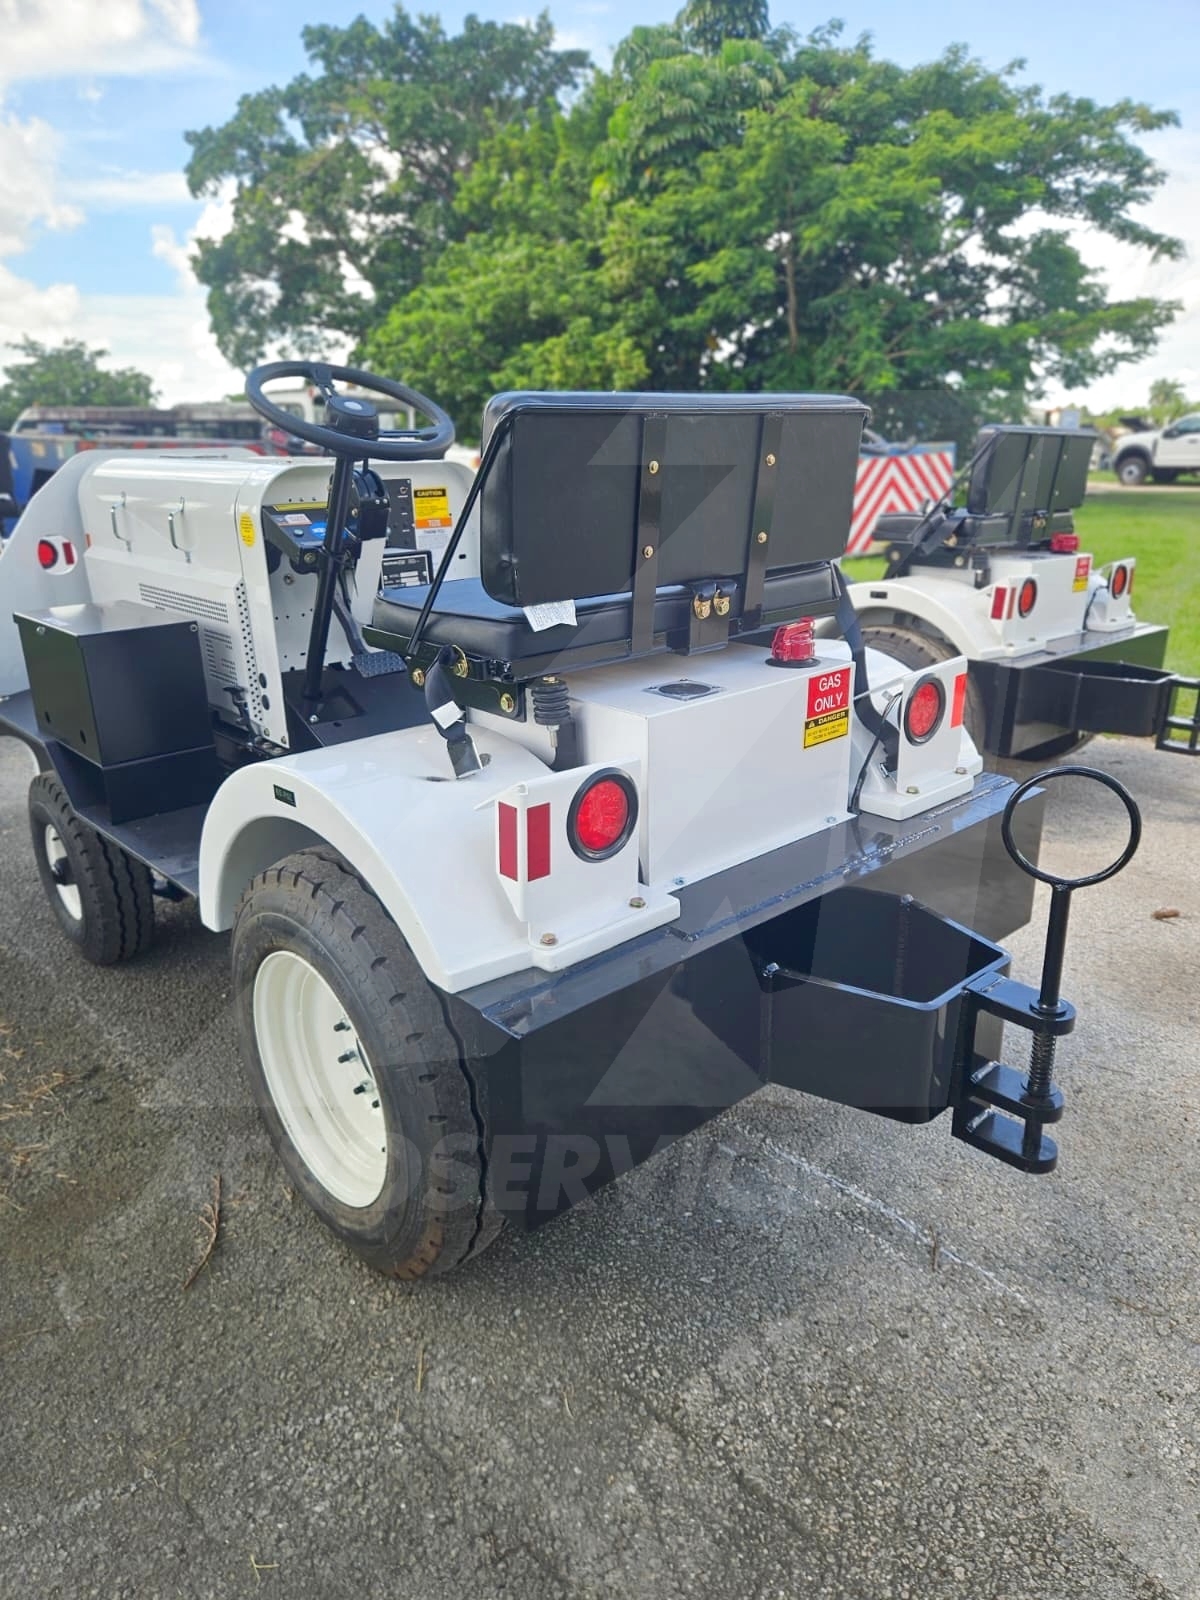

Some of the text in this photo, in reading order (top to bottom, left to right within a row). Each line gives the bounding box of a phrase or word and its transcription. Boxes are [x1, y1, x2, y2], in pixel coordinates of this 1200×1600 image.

[819, 673, 841, 691] GAS
[814, 691, 843, 712] ONLY
[818, 711, 846, 725] DANGER
